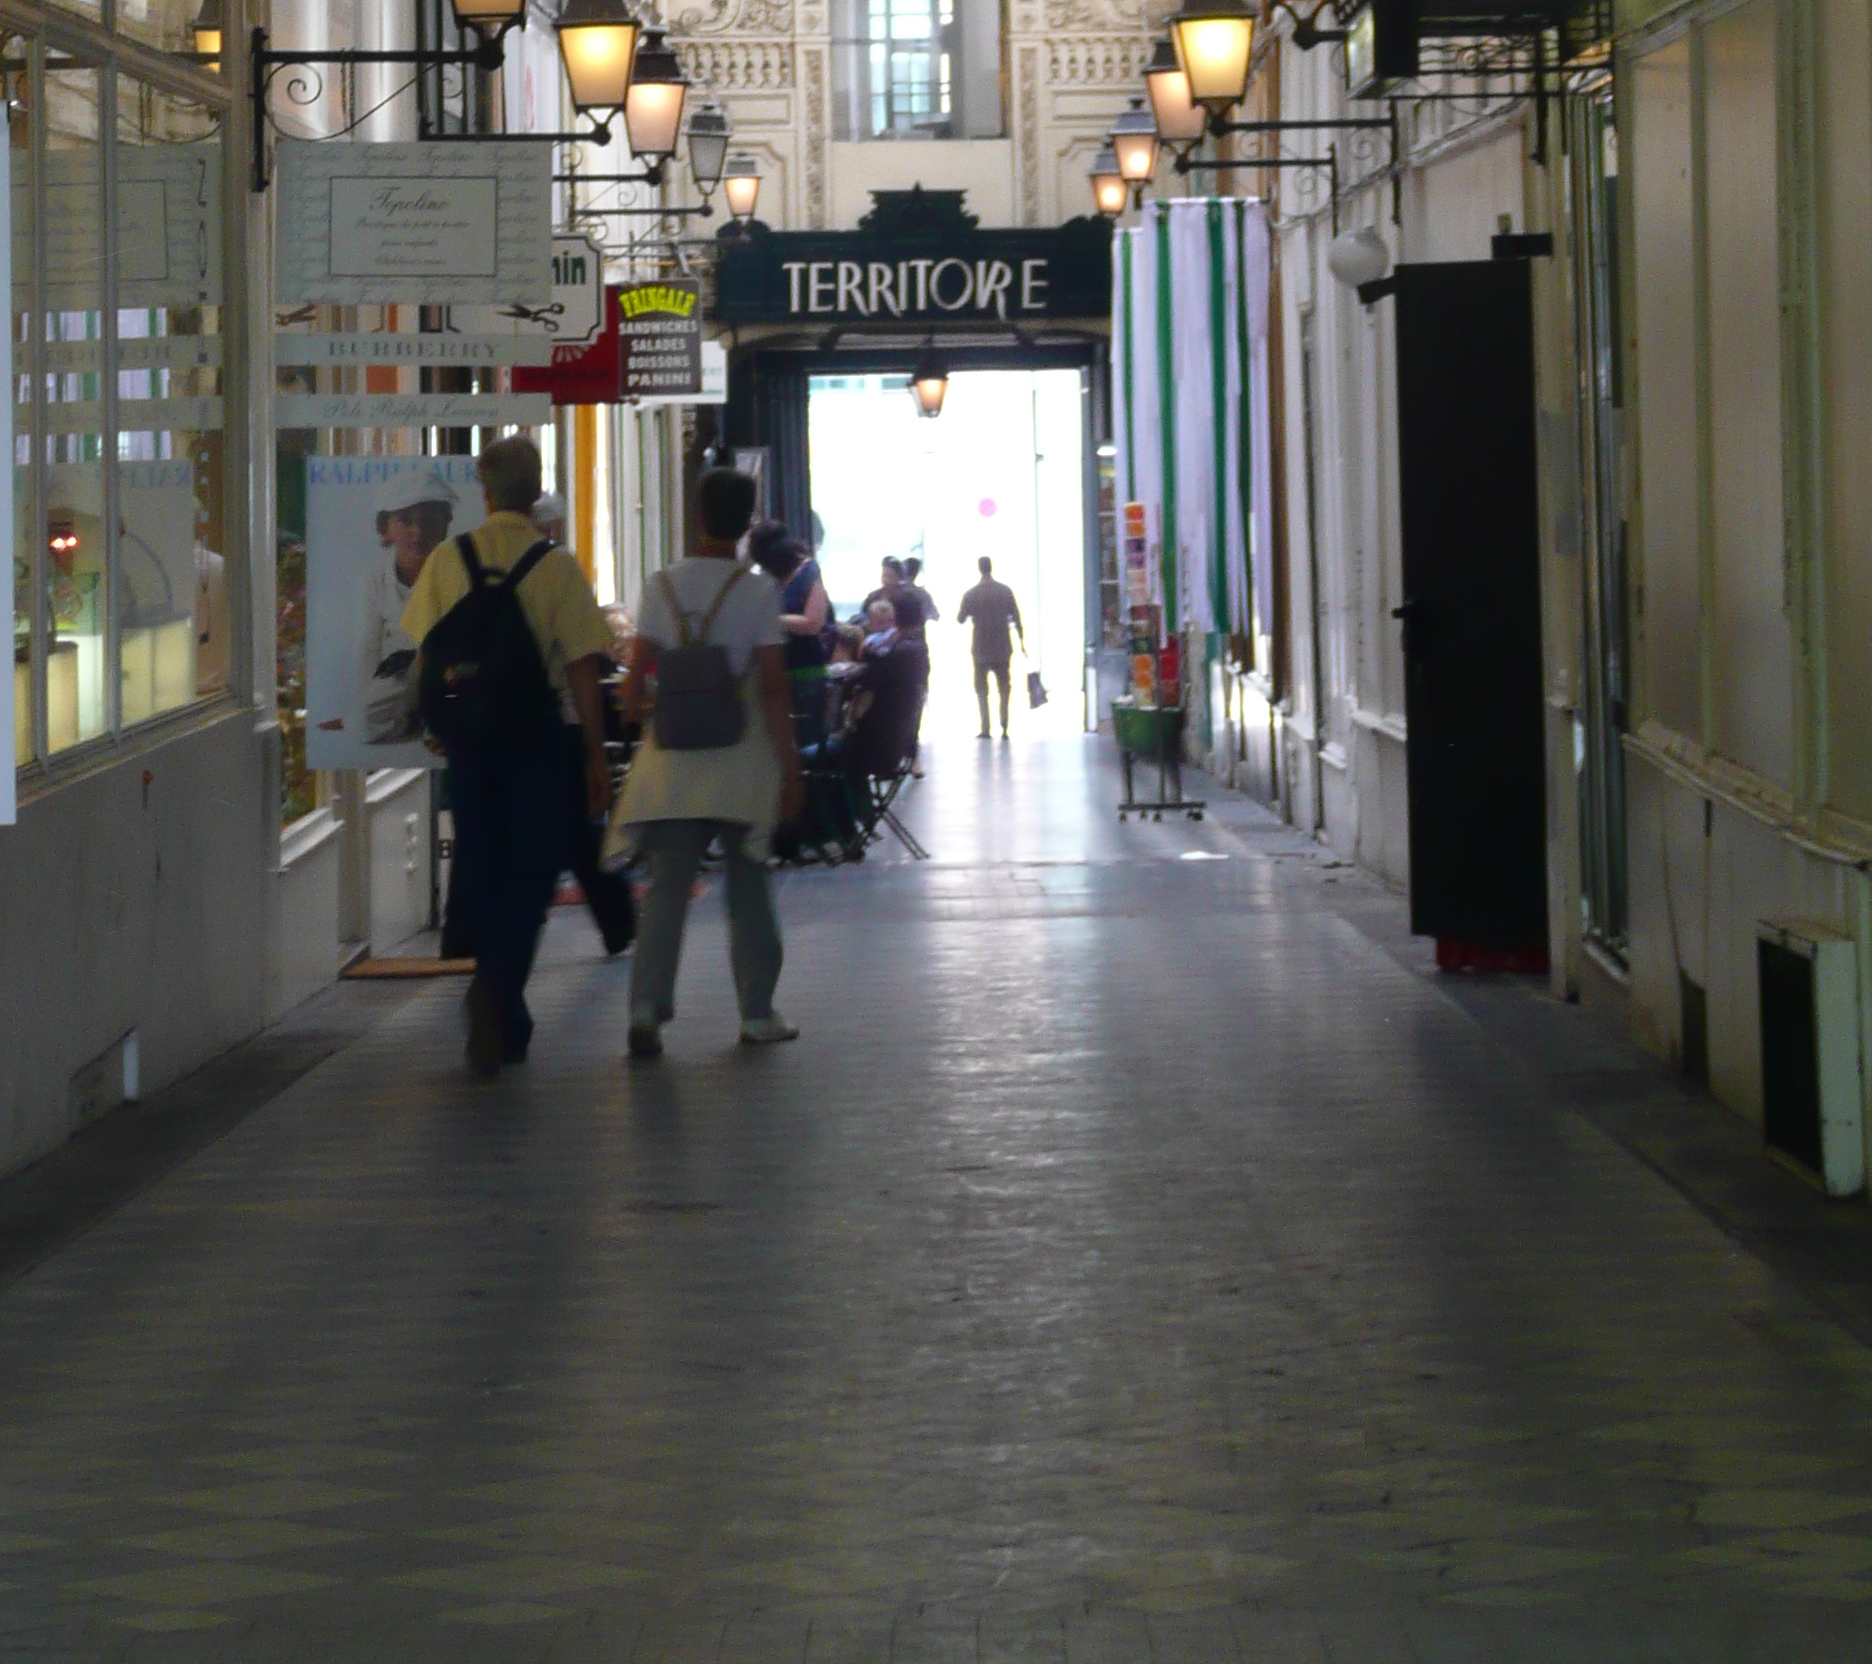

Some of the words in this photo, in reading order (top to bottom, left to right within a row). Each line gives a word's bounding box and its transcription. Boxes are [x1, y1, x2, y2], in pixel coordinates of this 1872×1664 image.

[368, 187, 449, 217] Topolino
[782, 258, 1049, 319] TERRITOIRE
[619, 320, 698, 335] SANDWICHES
[328, 342, 498, 357] BURBERRY
[631, 339, 688, 353] SALADES
[628, 372, 692, 387] PANINI
[368, 401, 430, 423] Ralph
[436, 403, 499, 418] Lauren
